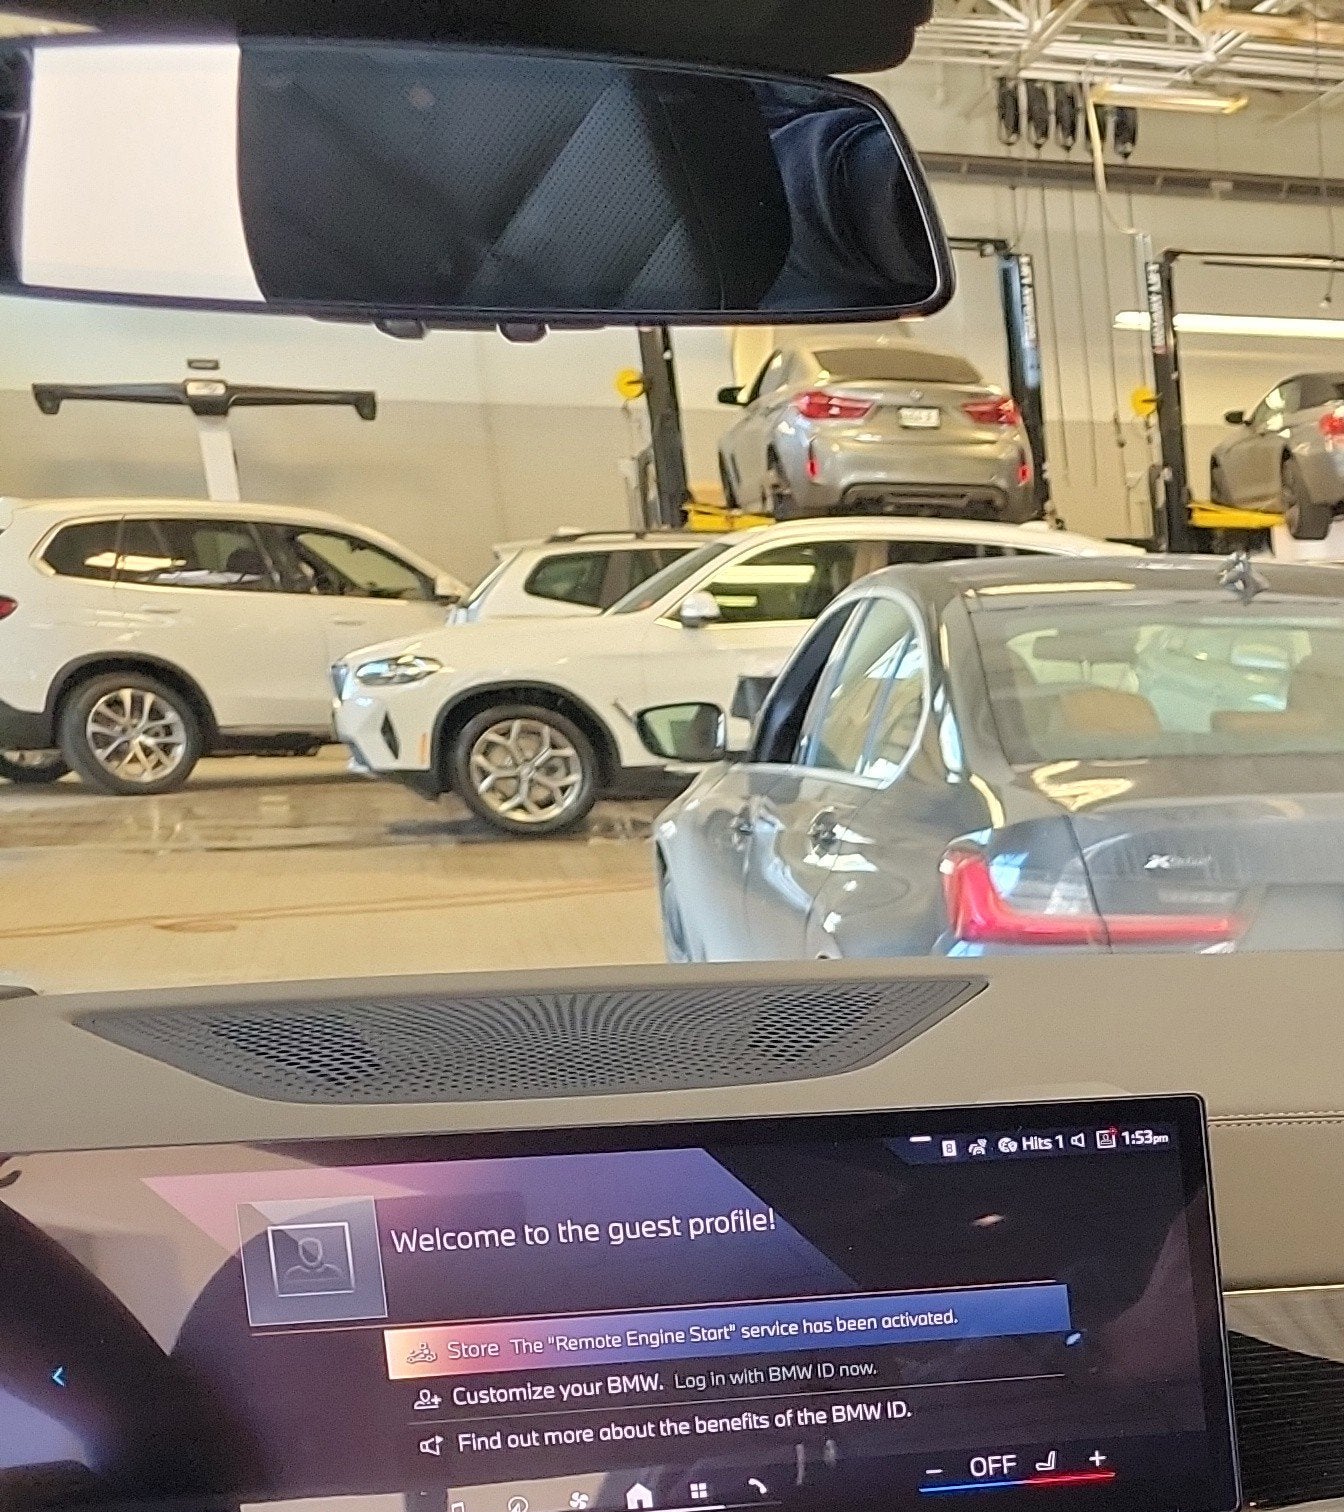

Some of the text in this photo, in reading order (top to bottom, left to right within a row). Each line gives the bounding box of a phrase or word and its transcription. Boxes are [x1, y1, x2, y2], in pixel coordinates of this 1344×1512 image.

[1022, 1135, 1064, 1150] Hits 1
[1121, 1129, 1169, 1146] 1:53pm
[391, 1207, 776, 1253] Welcome to the guest profile!
[448, 1308, 958, 1359] Store The "Remote Engine Start" service has been activated.
[453, 1361, 878, 1406] Customize your BMW. Log in with BMW ID now.
[458, 1400, 912, 1452] Find out more about the benefits of the BMW ID.
[970, 1454, 1017, 1477] OFF
